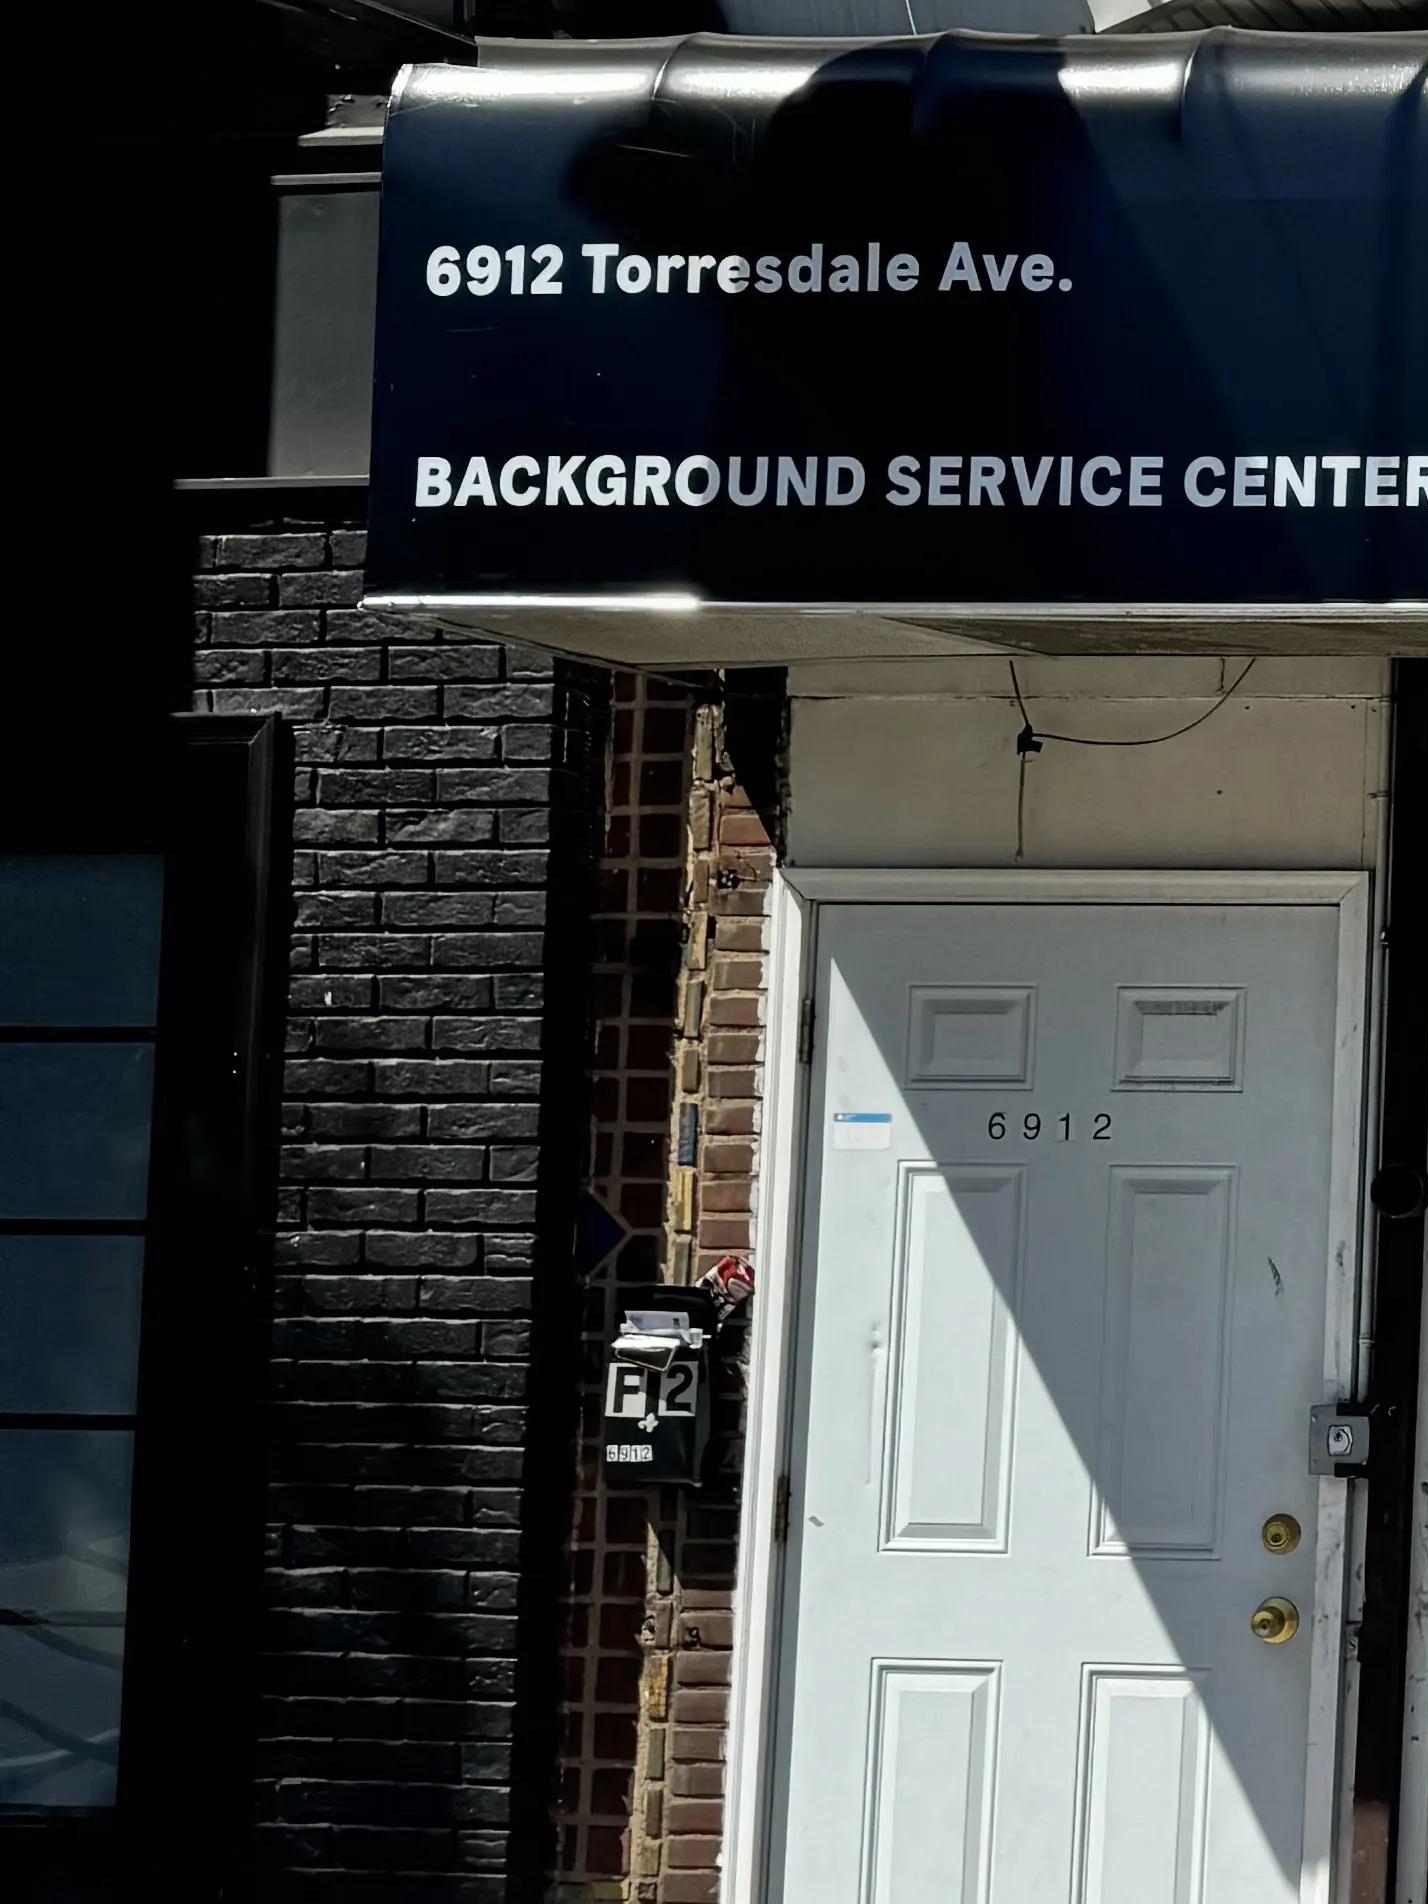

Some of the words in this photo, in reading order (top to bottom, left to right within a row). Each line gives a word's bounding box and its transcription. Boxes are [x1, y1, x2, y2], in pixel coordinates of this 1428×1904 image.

[426, 243, 564, 297] 6912
[581, 242, 920, 294] Torresdale
[937, 241, 1073, 293] Ave.
[414, 454, 866, 508] BACKGROUND
[885, 455, 1164, 507] SERVICE
[988, 1112, 1113, 1142] 6912
[607, 1446, 652, 1462] 6912
